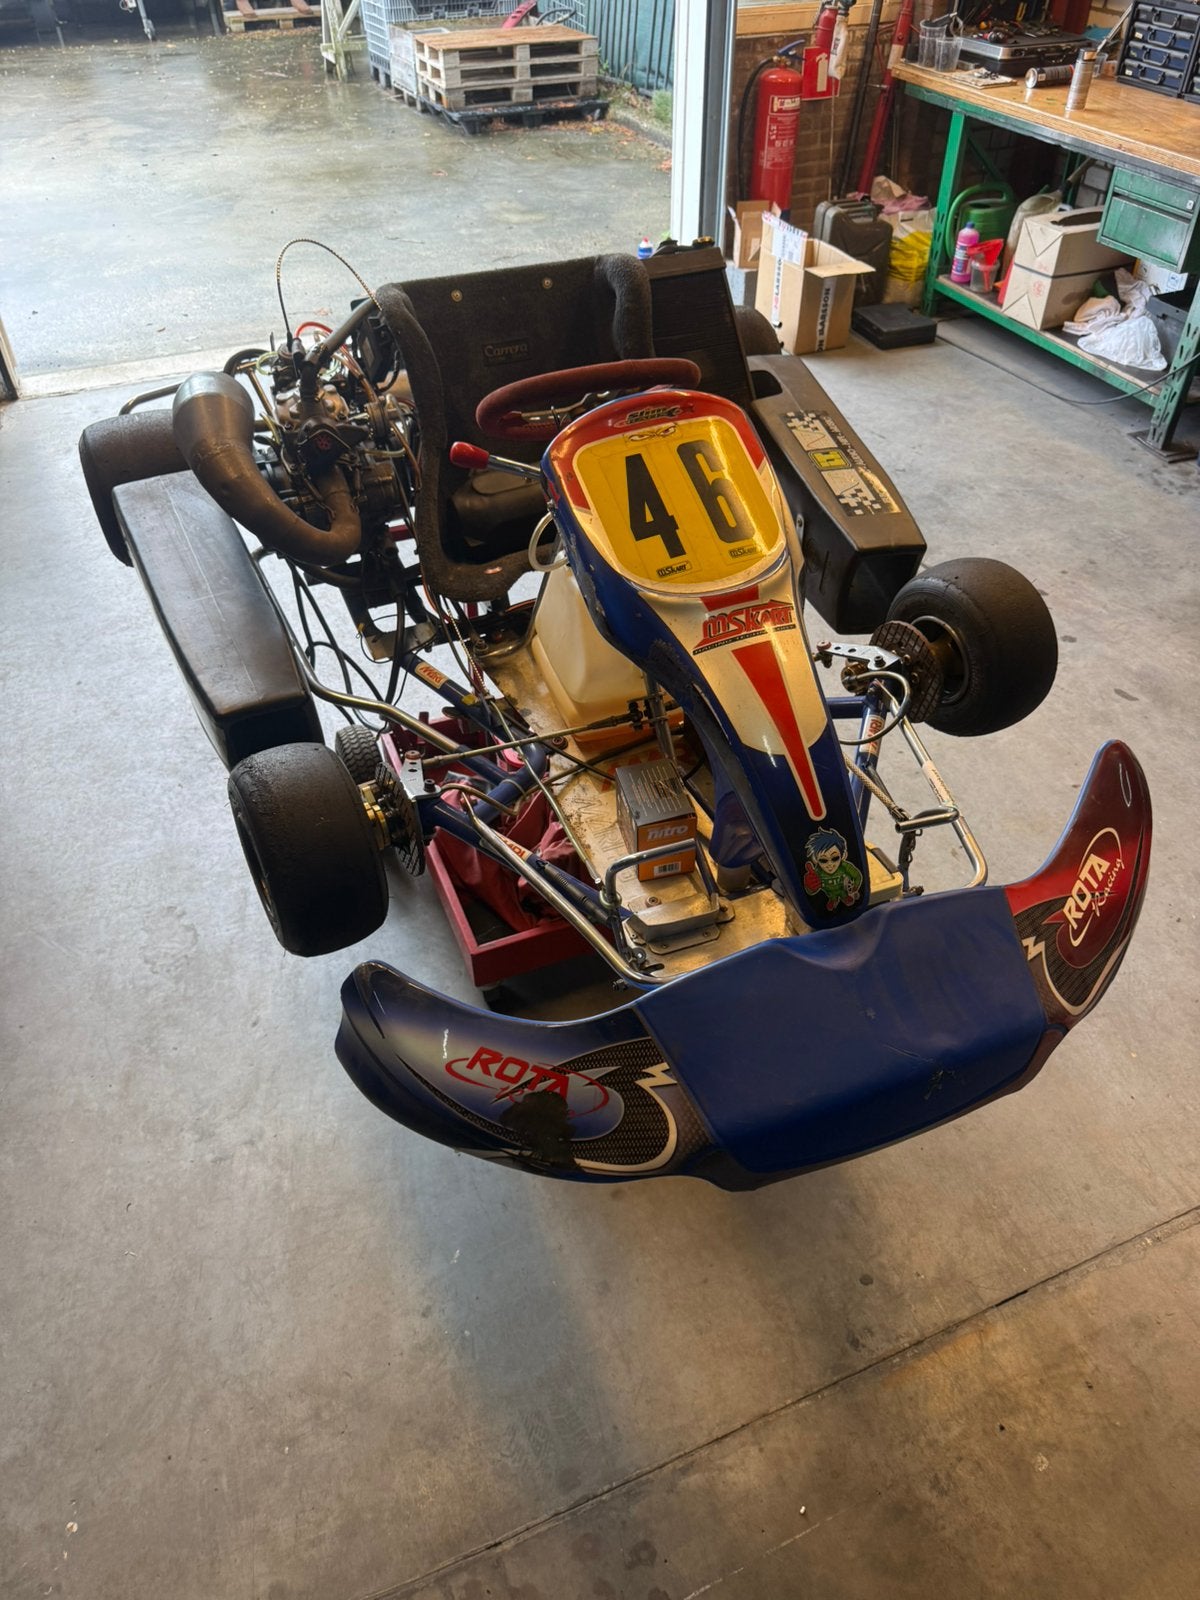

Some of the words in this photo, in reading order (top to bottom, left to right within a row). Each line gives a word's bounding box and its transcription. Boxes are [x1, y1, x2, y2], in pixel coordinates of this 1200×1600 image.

[647, 825, 689, 841] nitro
[1063, 853, 1111, 930] ROTA
[1091, 858, 1125, 917] Racing
[466, 1047, 570, 1101] ROTA
